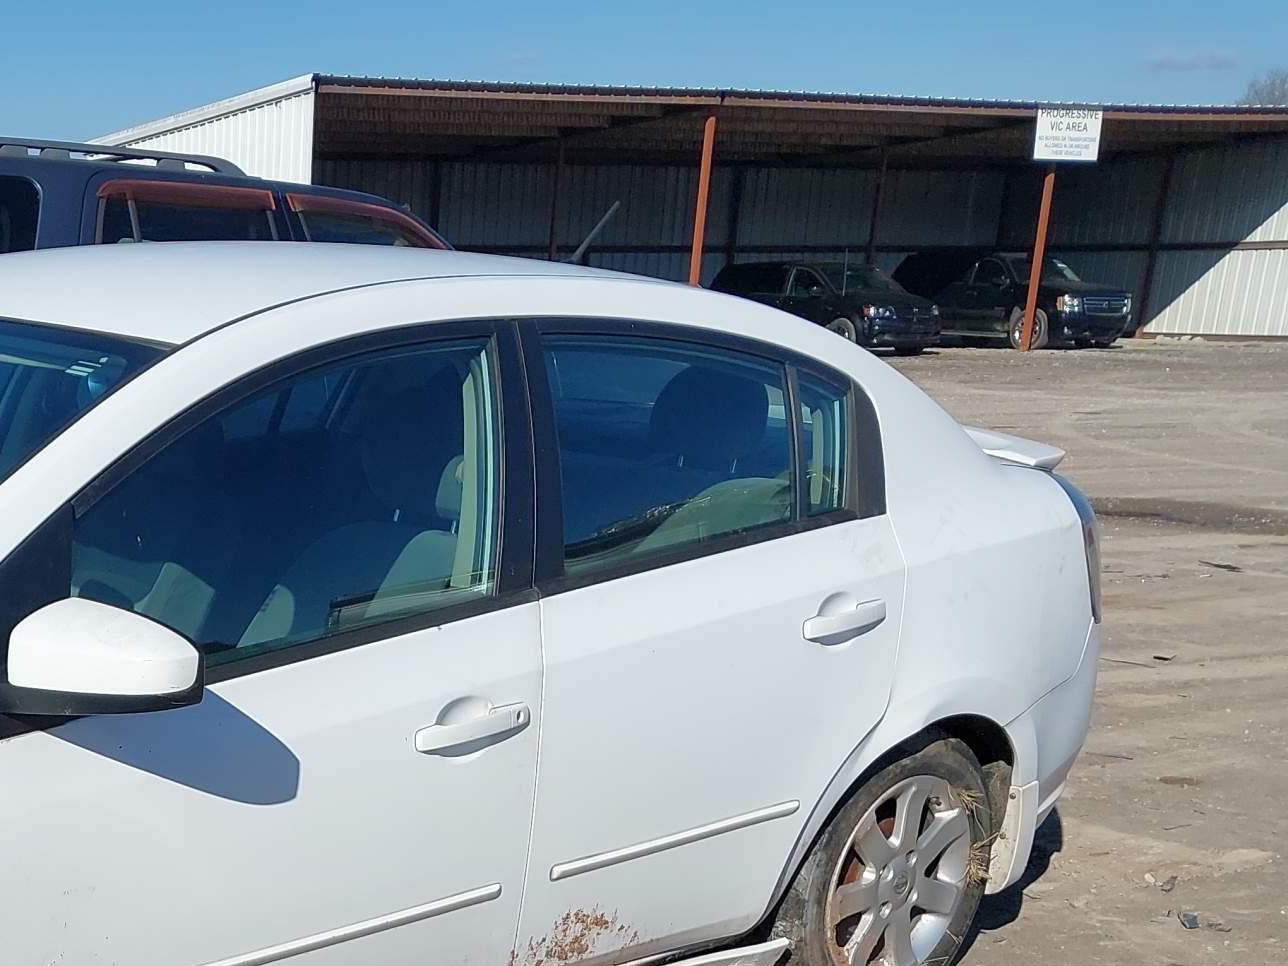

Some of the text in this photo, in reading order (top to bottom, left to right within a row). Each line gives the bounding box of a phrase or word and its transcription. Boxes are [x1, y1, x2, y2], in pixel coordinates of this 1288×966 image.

[1041, 108, 1100, 120] PROGRESSIVE
[1050, 121, 1088, 132] VIC AREA
